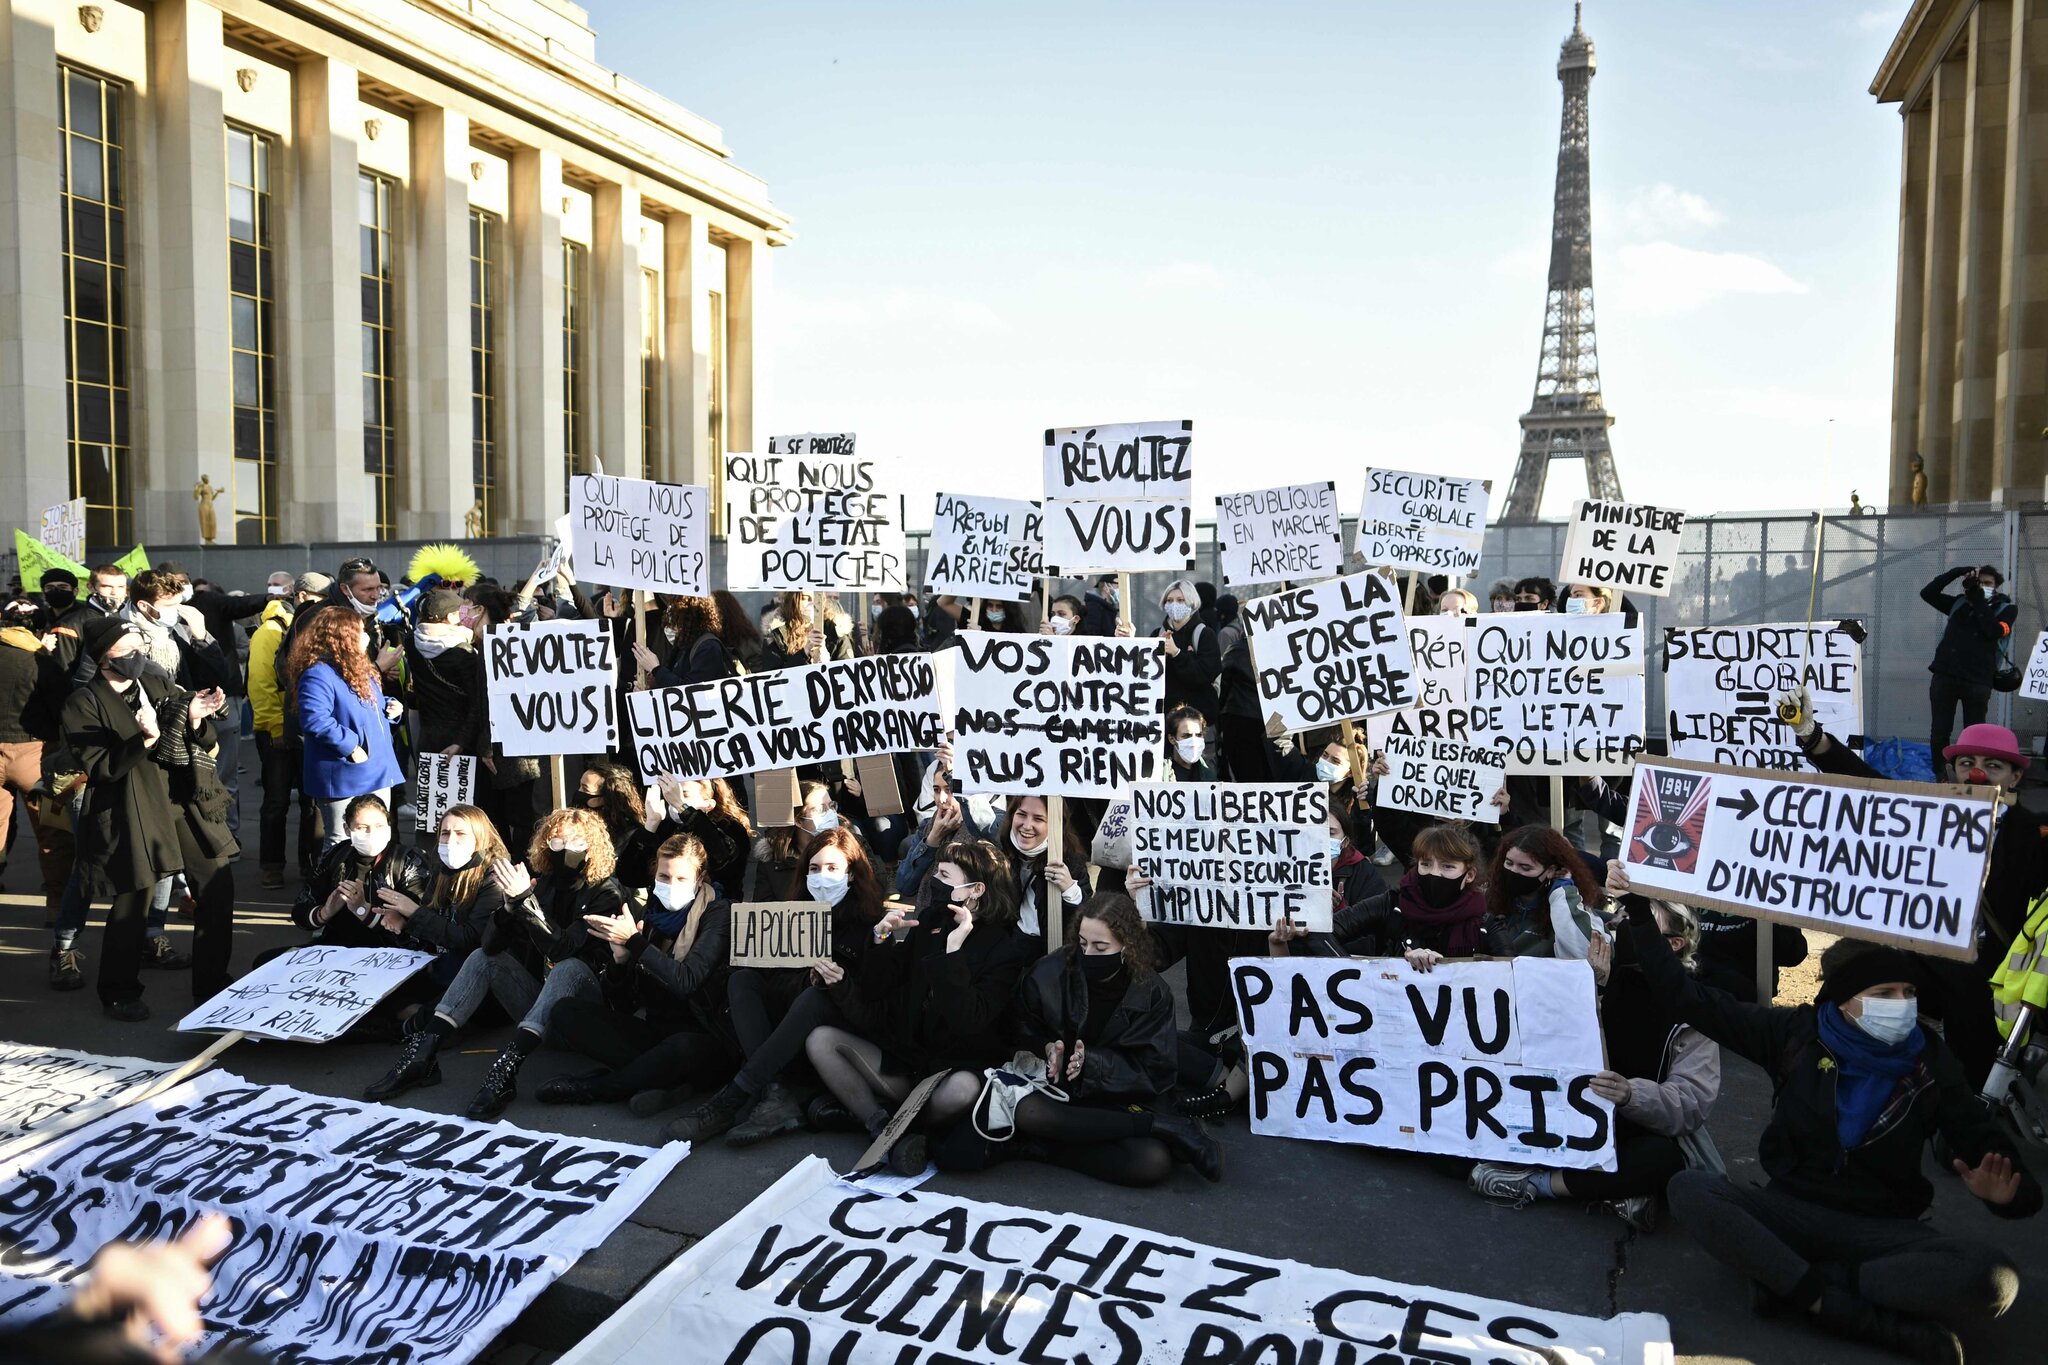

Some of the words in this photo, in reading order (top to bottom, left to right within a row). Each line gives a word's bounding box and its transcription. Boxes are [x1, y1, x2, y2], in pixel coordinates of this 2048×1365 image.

[729, 457, 783, 485] QUI
[799, 462, 874, 492] NOUS
[1061, 429, 1191, 487] RÉVOLTEZ
[649, 486, 692, 519] NOUS
[936, 495, 953, 516] LA
[584, 505, 653, 543] PROTÈGE
[670, 523, 688, 548] DE
[739, 516, 777, 544] DE
[1066, 505, 1191, 556] VOUS!
[1233, 523, 1254, 544] EN
[1272, 514, 1334, 539] MARCHE
[1592, 529, 1616, 551] DE
[1627, 533, 1655, 555] LA
[595, 541, 614, 570] LA
[762, 549, 902, 586] POLICIER
[1578, 557, 1669, 588] HONTE
[1242, 588, 1319, 636] MAIS
[1340, 574, 1391, 611] LA
[491, 625, 612, 681] RÉVOLTEZ
[1287, 610, 1397, 666] FORCE
[1546, 629, 1631, 661] NOUS
[1667, 628, 1851, 662] SECURITE
[954, 635, 1052, 675] VOS
[1072, 642, 1165, 680] ARMES
[1260, 665, 1302, 700] DE
[1314, 653, 1405, 690] QUEL
[1475, 665, 1605, 700] PROTEGE
[511, 684, 616, 741] VOUS!
[1013, 679, 1151, 715] CONTRE
[1297, 674, 1412, 722] ORDRE
[955, 707, 1020, 738] NOS
[1471, 704, 1502, 731] DE
[1522, 703, 1624, 731] L'ETAT
[640, 739, 711, 777] QUAND
[714, 732, 755, 774] ÇA
[758, 721, 825, 765] VOUS
[832, 708, 945, 755] ARRANGE
[1431, 741, 1459, 762] LES
[1460, 745, 1506, 769] FORCES
[967, 746, 1044, 787] PLUS
[1402, 761, 1428, 783] DE
[1433, 765, 1480, 790] QUEL
[1133, 789, 1186, 820] NOS
[1660, 777, 1692, 797] 1984
[1100, 821, 1128, 839] POWER
[1763, 785, 1831, 830] CECI
[1835, 793, 1939, 841] N'EST
[1938, 803, 1991, 854] PAS
[1135, 827, 1161, 851] SE
[1165, 828, 1300, 858] MEURENT
[1750, 828, 1793, 861] UN
[1800, 834, 1948, 888] MANUEL
[1138, 857, 1162, 879] EN
[1165, 858, 1225, 882] TOUTE
[1707, 859, 1962, 937] D'INSTRUCTION
[733, 911, 756, 957] LA
[806, 911, 832, 958] TUE
[286, 949, 337, 966] VOS
[351, 951, 421, 970] ARMES
[290, 969, 368, 988] CONTRE
[196, 1006, 269, 1025] PLUS
[1233, 965, 1373, 1038] PAS
[1405, 985, 1510, 1054] VU
[156, 1088, 271, 1122] SI
[217, 1097, 361, 1142] LES
[1252, 1051, 1383, 1125] PAS
[1418, 1061, 1608, 1151] PRIS
[829, 1191, 1280, 1322] CACHEZ
[735, 1225, 1155, 1365] VIOLENCES
